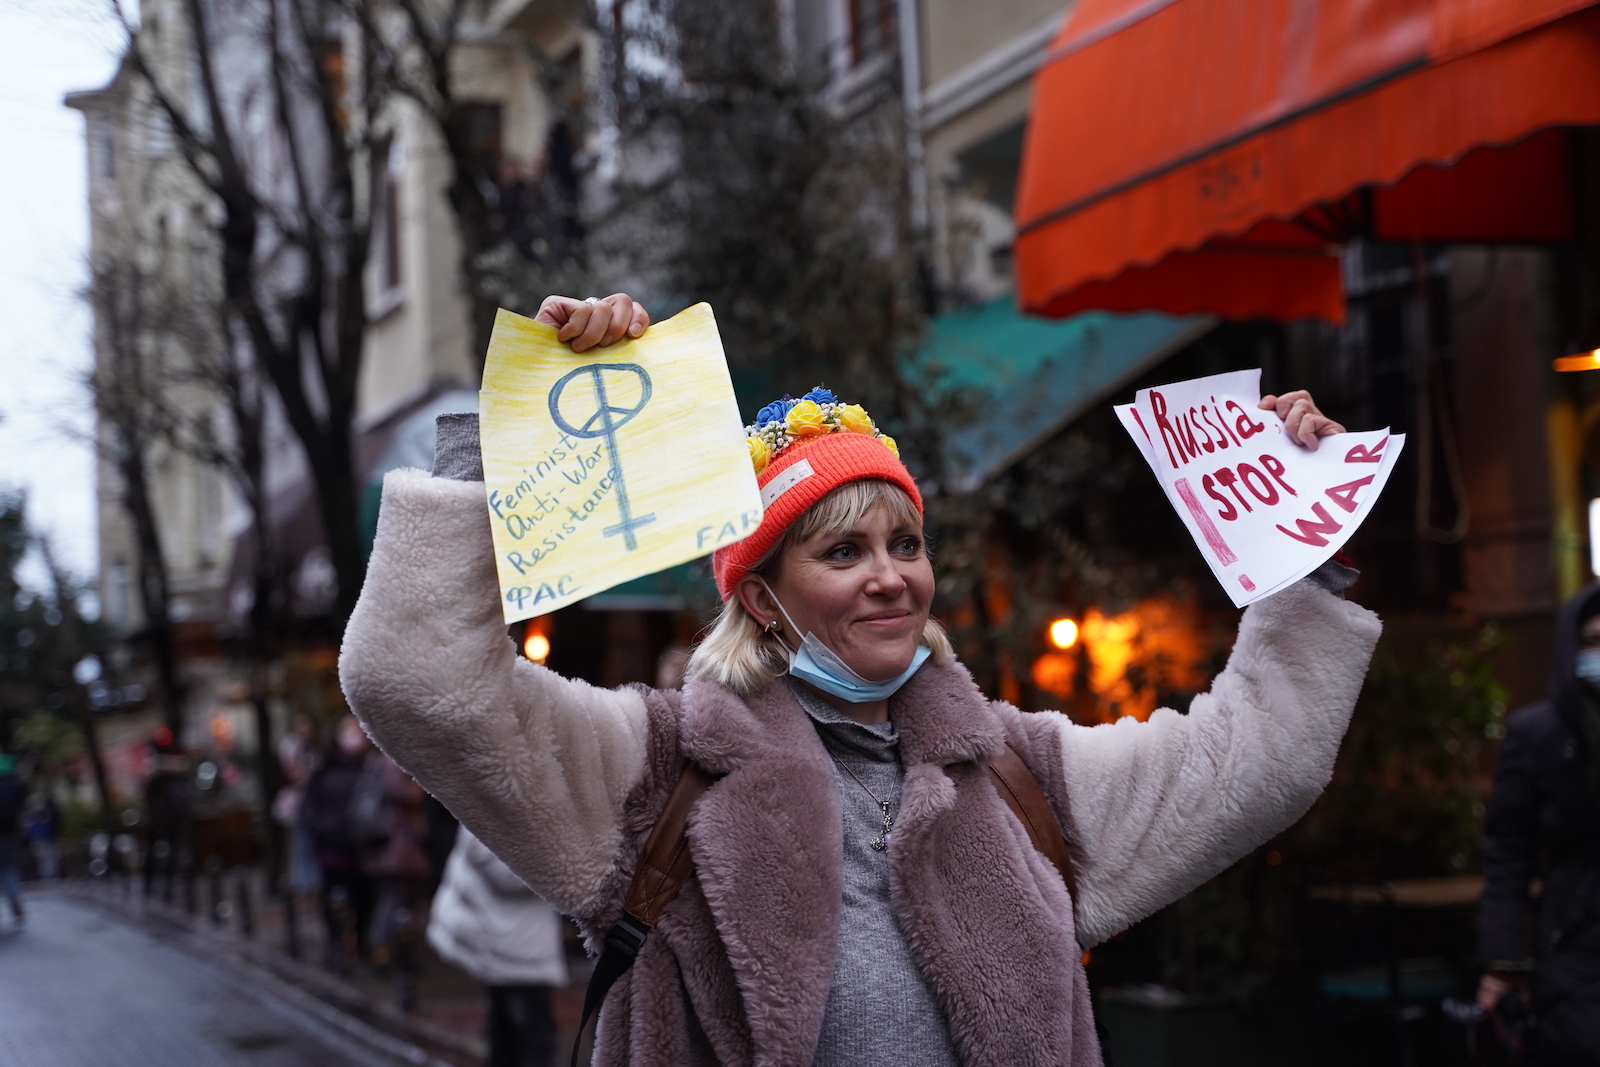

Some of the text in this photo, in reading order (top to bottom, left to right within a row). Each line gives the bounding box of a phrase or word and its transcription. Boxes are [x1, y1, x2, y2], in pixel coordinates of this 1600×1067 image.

[489, 431, 577, 520] Feminist
[1202, 454, 1298, 521] STOP
[1275, 435, 1389, 548] WAR
[507, 468, 621, 575] Resistance
[696, 509, 759, 550] FAR
